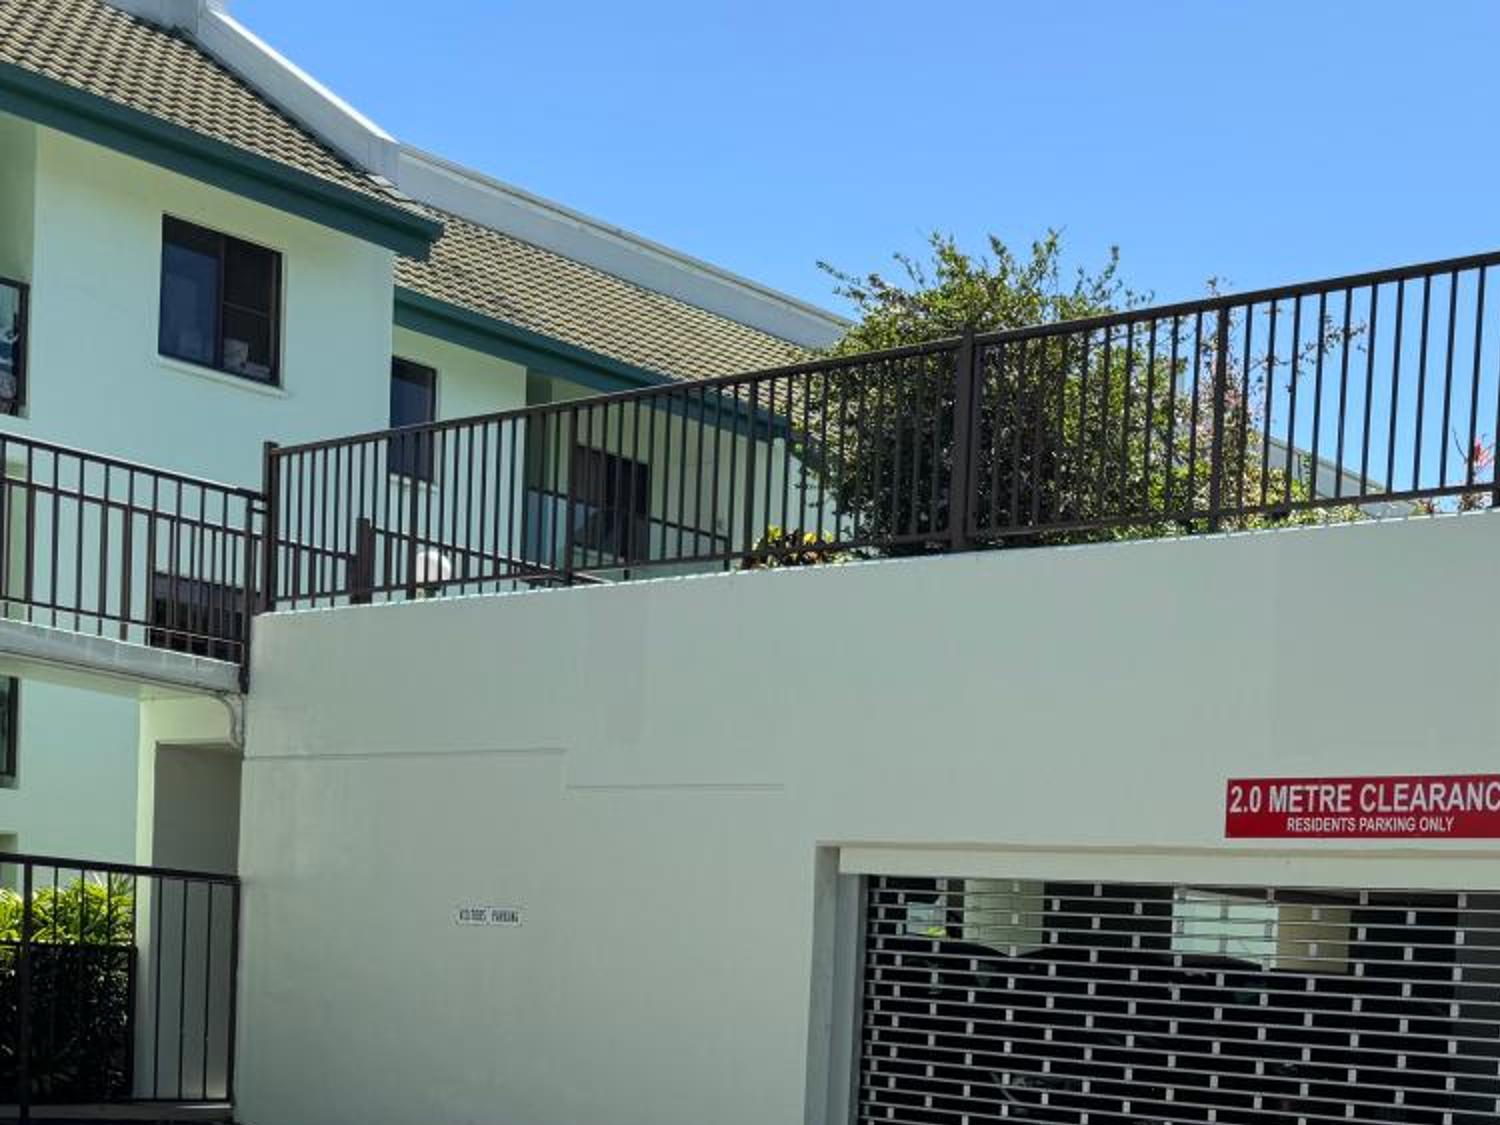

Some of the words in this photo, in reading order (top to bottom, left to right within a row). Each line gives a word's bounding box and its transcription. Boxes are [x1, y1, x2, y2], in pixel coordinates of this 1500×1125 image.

[1229, 785, 1262, 813] 2.0
[1268, 783, 1352, 813] METRE
[1287, 817, 1355, 833] RESIDENTS
[1359, 816, 1416, 832] PARKING
[1419, 816, 1455, 832] ONLY
